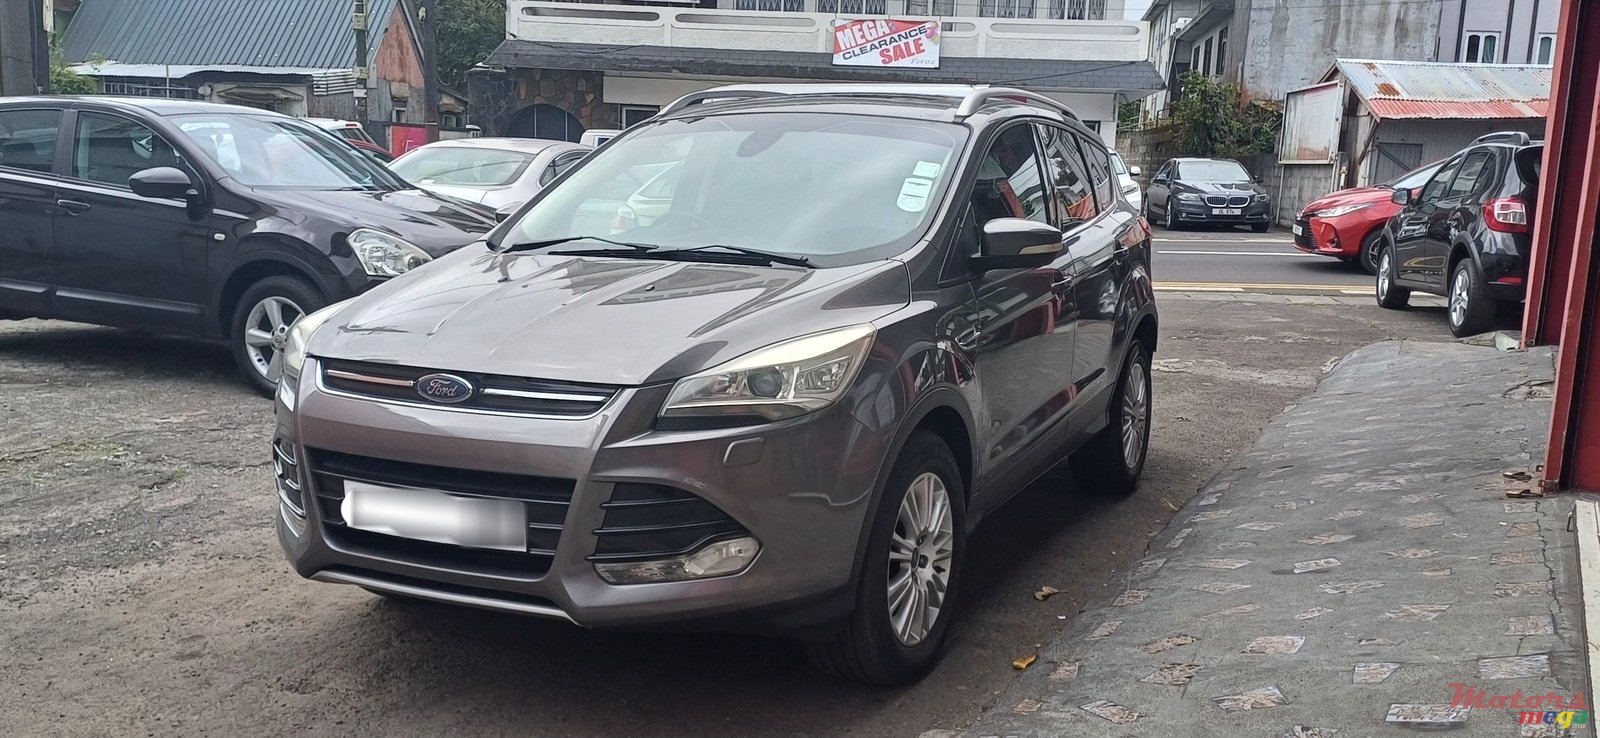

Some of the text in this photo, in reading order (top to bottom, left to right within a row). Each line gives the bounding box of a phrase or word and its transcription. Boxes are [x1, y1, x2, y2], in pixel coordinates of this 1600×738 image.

[836, 19, 891, 51] MEGA
[842, 25, 928, 60] CLEARANCE
[879, 38, 925, 65] SALE
[426, 379, 458, 397] Ford
